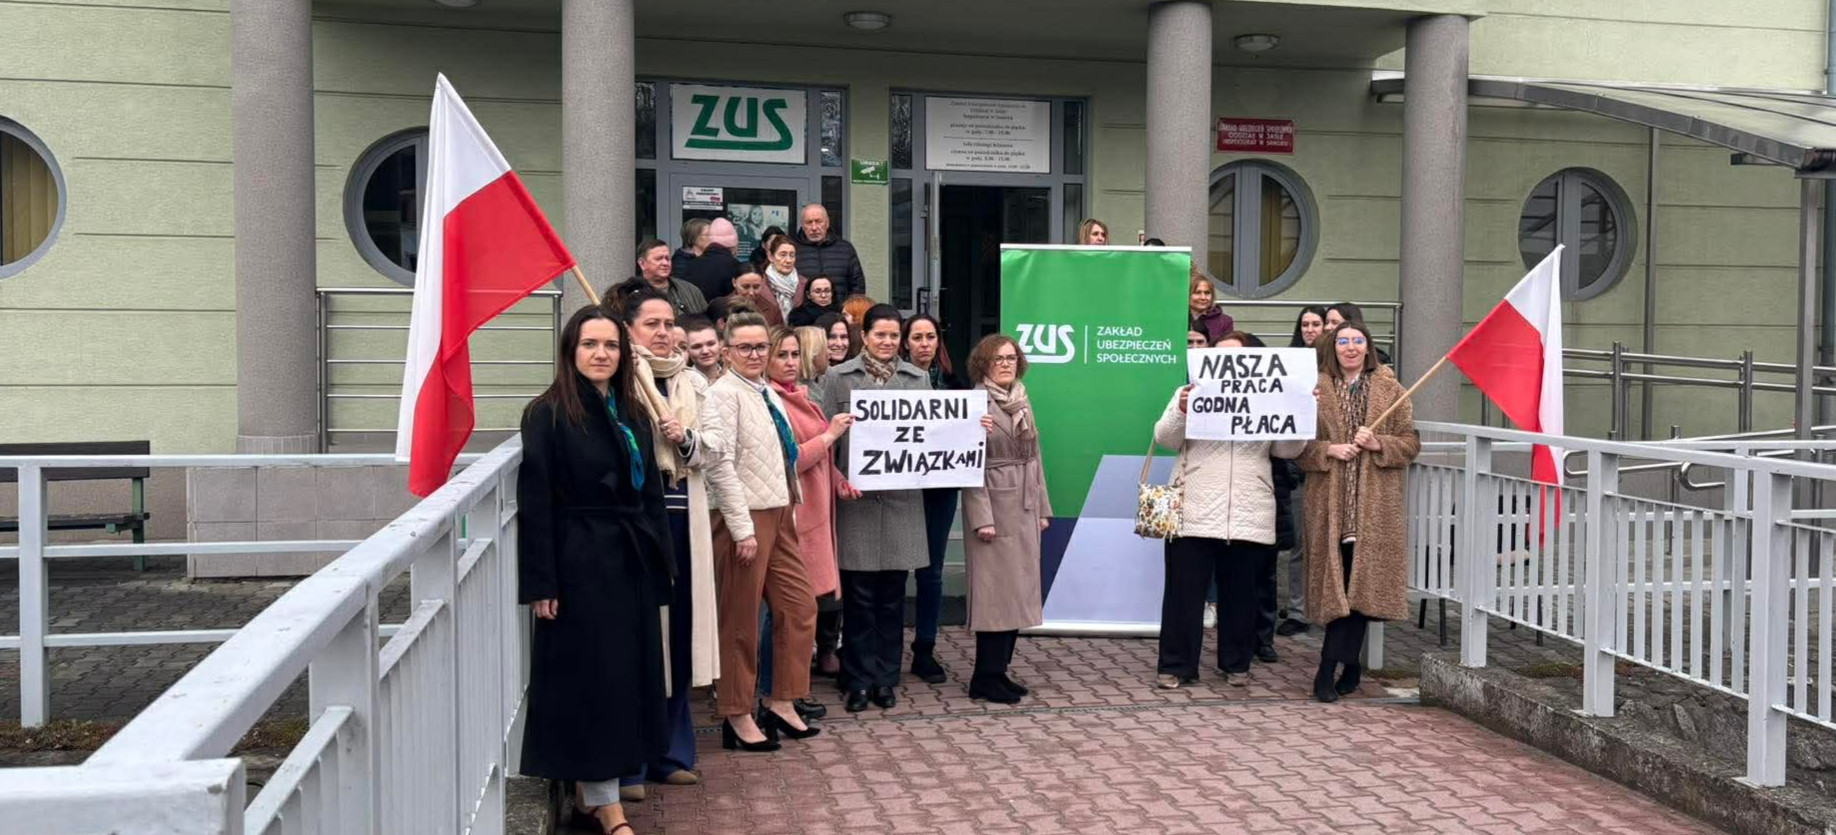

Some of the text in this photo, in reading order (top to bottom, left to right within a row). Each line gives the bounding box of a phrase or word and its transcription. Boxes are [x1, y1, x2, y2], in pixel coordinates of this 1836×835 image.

[684, 94, 793, 151] ZUS
[1097, 326, 1142, 337] ZAKŁAD
[1016, 324, 1075, 363] ZUS
[1096, 338, 1172, 350] UBEZPIECZEŃ
[1096, 353, 1177, 364] SPOŁECZNYCH
[1198, 353, 1288, 379] NASZA
[1221, 378, 1283, 394] PRACA
[855, 398, 968, 422] SOLIDARNI
[1192, 396, 1251, 414] GODNA
[1231, 414, 1297, 435] PŁACA
[893, 426, 925, 443] ZE
